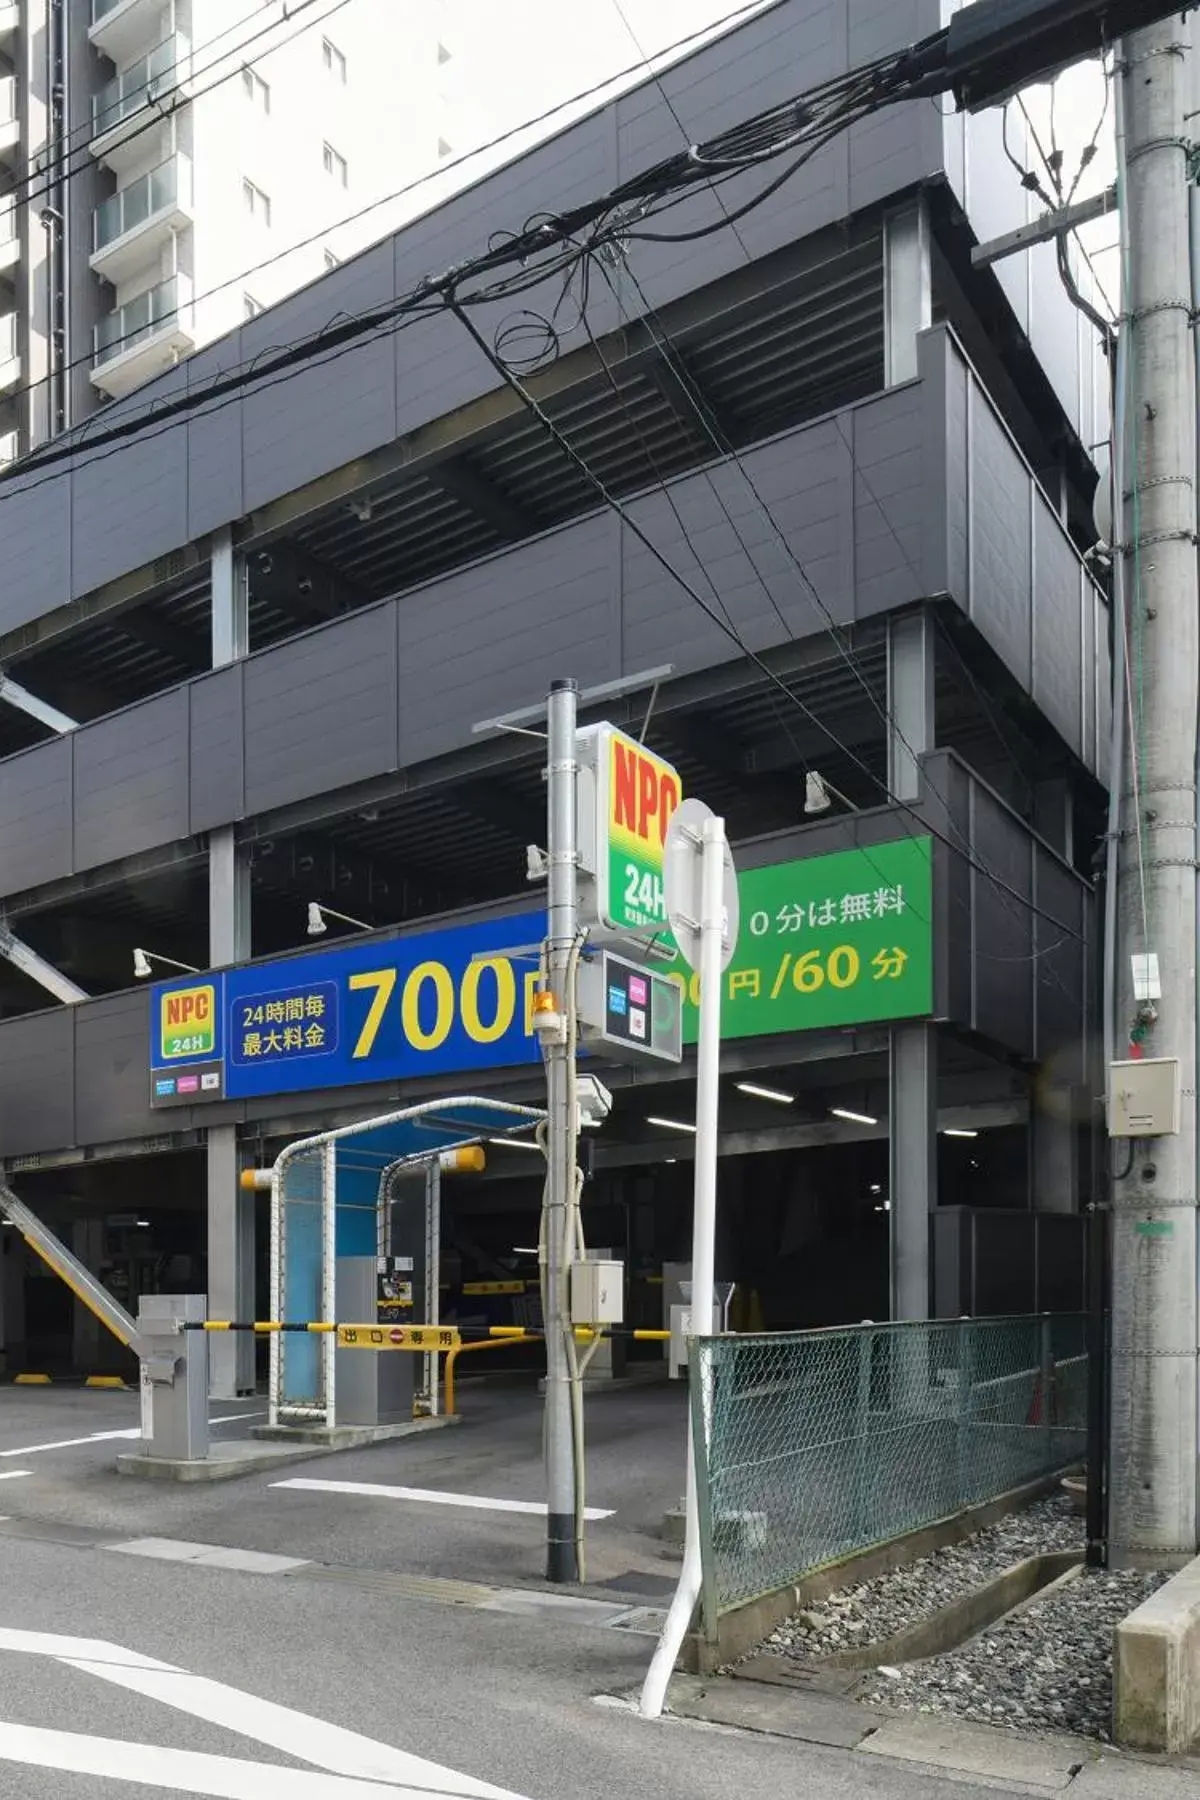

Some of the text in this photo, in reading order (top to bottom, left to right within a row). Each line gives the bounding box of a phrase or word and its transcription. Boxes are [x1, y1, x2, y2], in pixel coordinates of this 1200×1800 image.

[614, 740, 678, 850] NPC
[167, 993, 209, 1025] NPC
[243, 995, 325, 1028] 24時間毎
[172, 1037, 203, 1053] 24H
[243, 1023, 325, 1056] 最大料金
[345, 1329, 382, 1344] 出口
